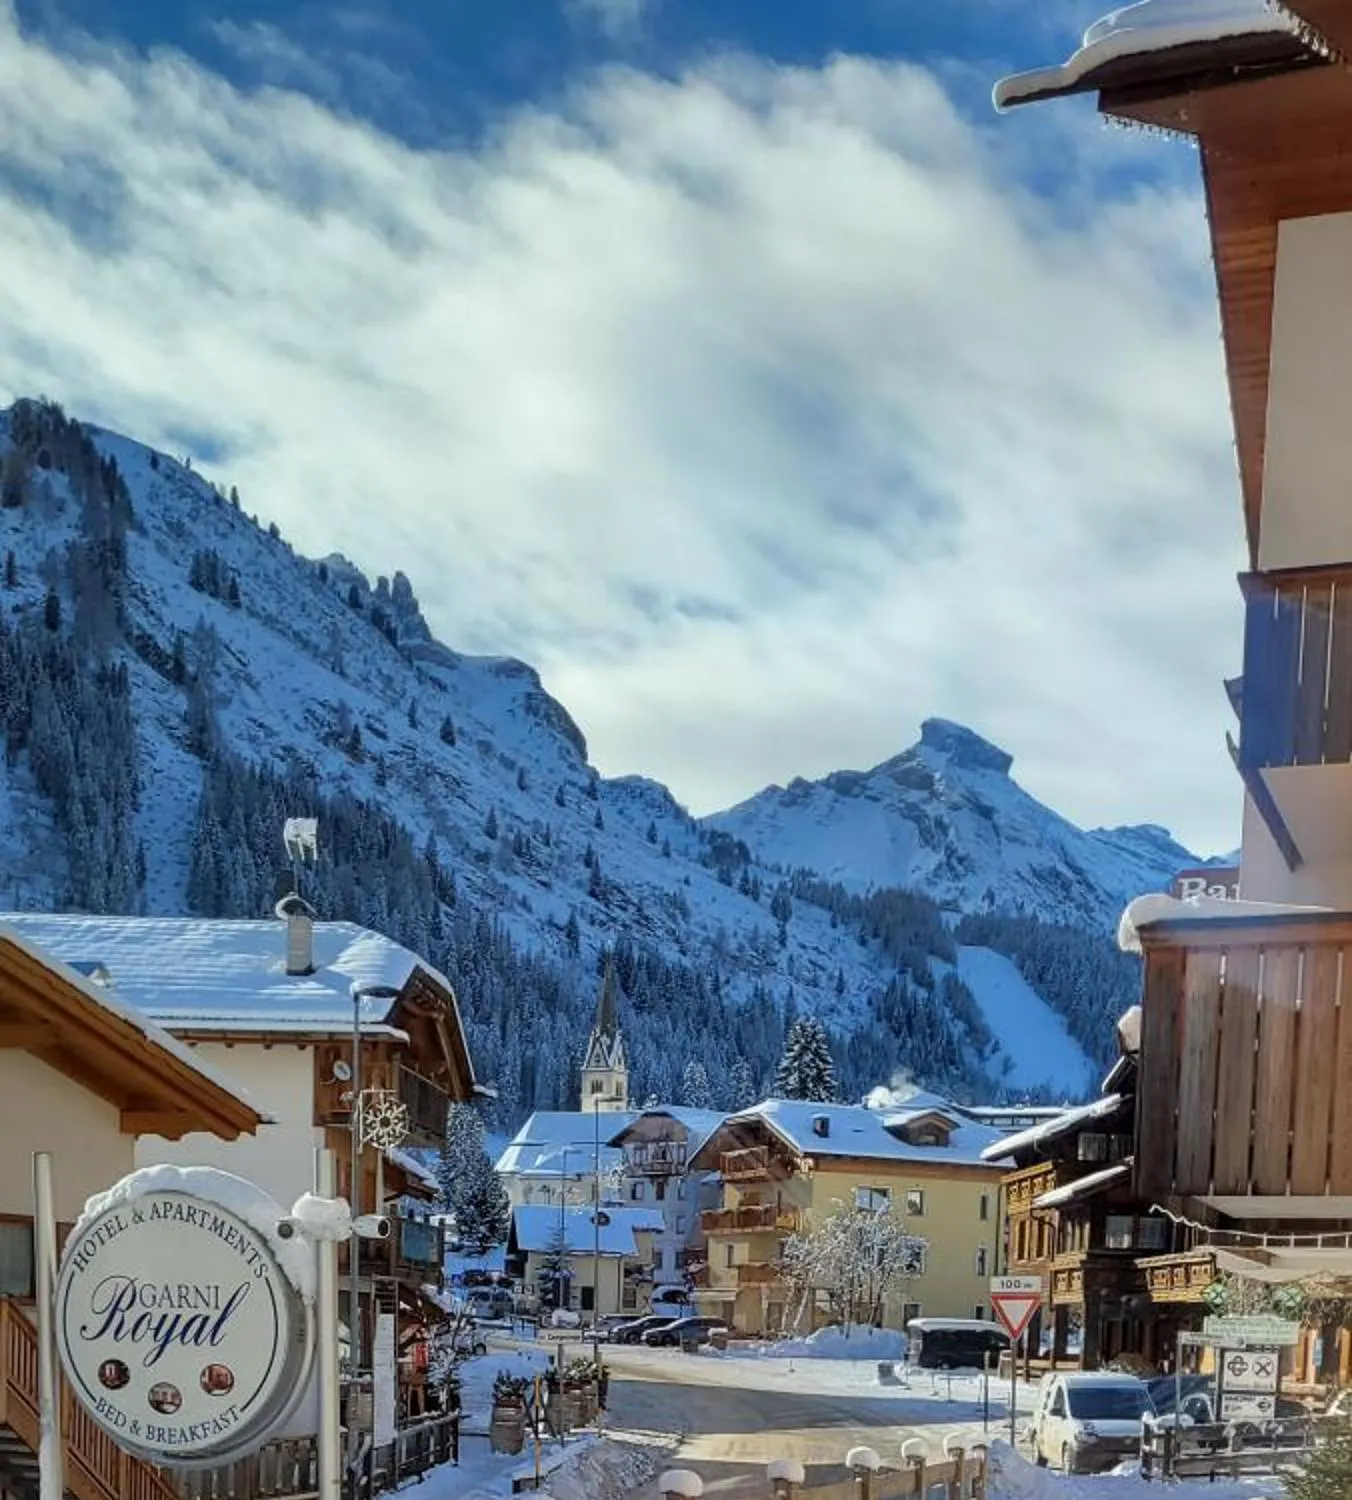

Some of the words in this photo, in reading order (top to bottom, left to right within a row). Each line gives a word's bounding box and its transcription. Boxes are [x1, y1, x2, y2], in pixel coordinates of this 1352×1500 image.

[73, 1216, 128, 1272] HOTEL
[131, 1208, 145, 1224] &
[150, 1201, 268, 1278] APARTMENTS
[139, 1283, 220, 1309] GARNI
[1001, 1279, 1021, 1289] 100
[80, 1275, 250, 1367] Royal
[95, 1397, 127, 1428] BED
[129, 1419, 141, 1435] &
[146, 1405, 240, 1444] BREAKFAST
